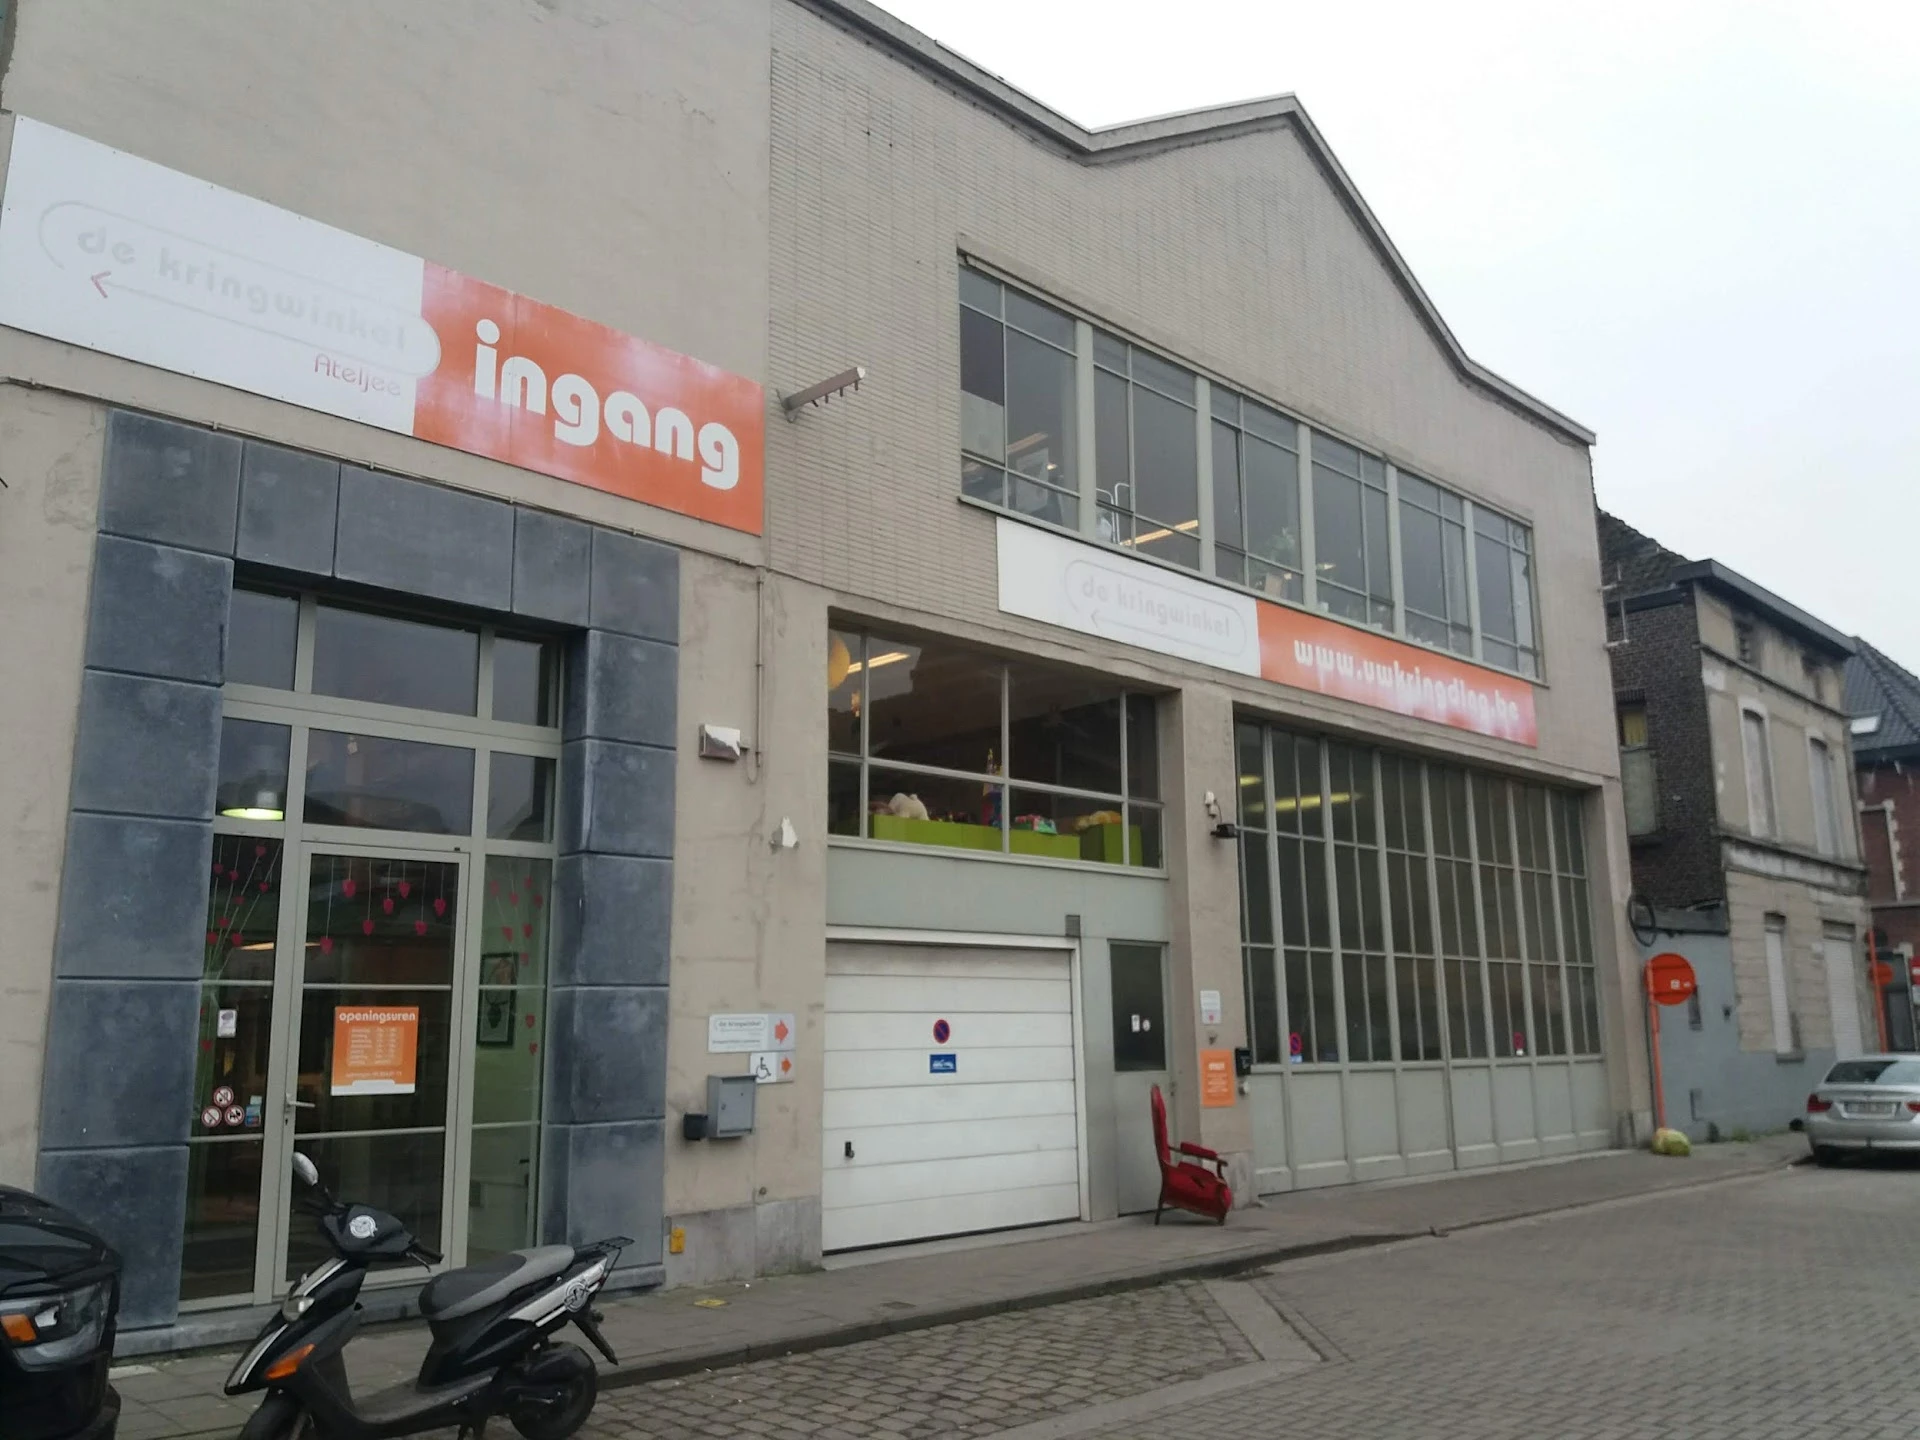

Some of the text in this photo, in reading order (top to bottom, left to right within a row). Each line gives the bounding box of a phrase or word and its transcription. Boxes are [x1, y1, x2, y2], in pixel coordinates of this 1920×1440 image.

[78, 227, 406, 350] de kringwinkel
[314, 353, 401, 397] Ateljee
[474, 318, 740, 491] ingang
[1082, 576, 1231, 638] de kringwinkel
[339, 1009, 416, 1024] openingsuren
